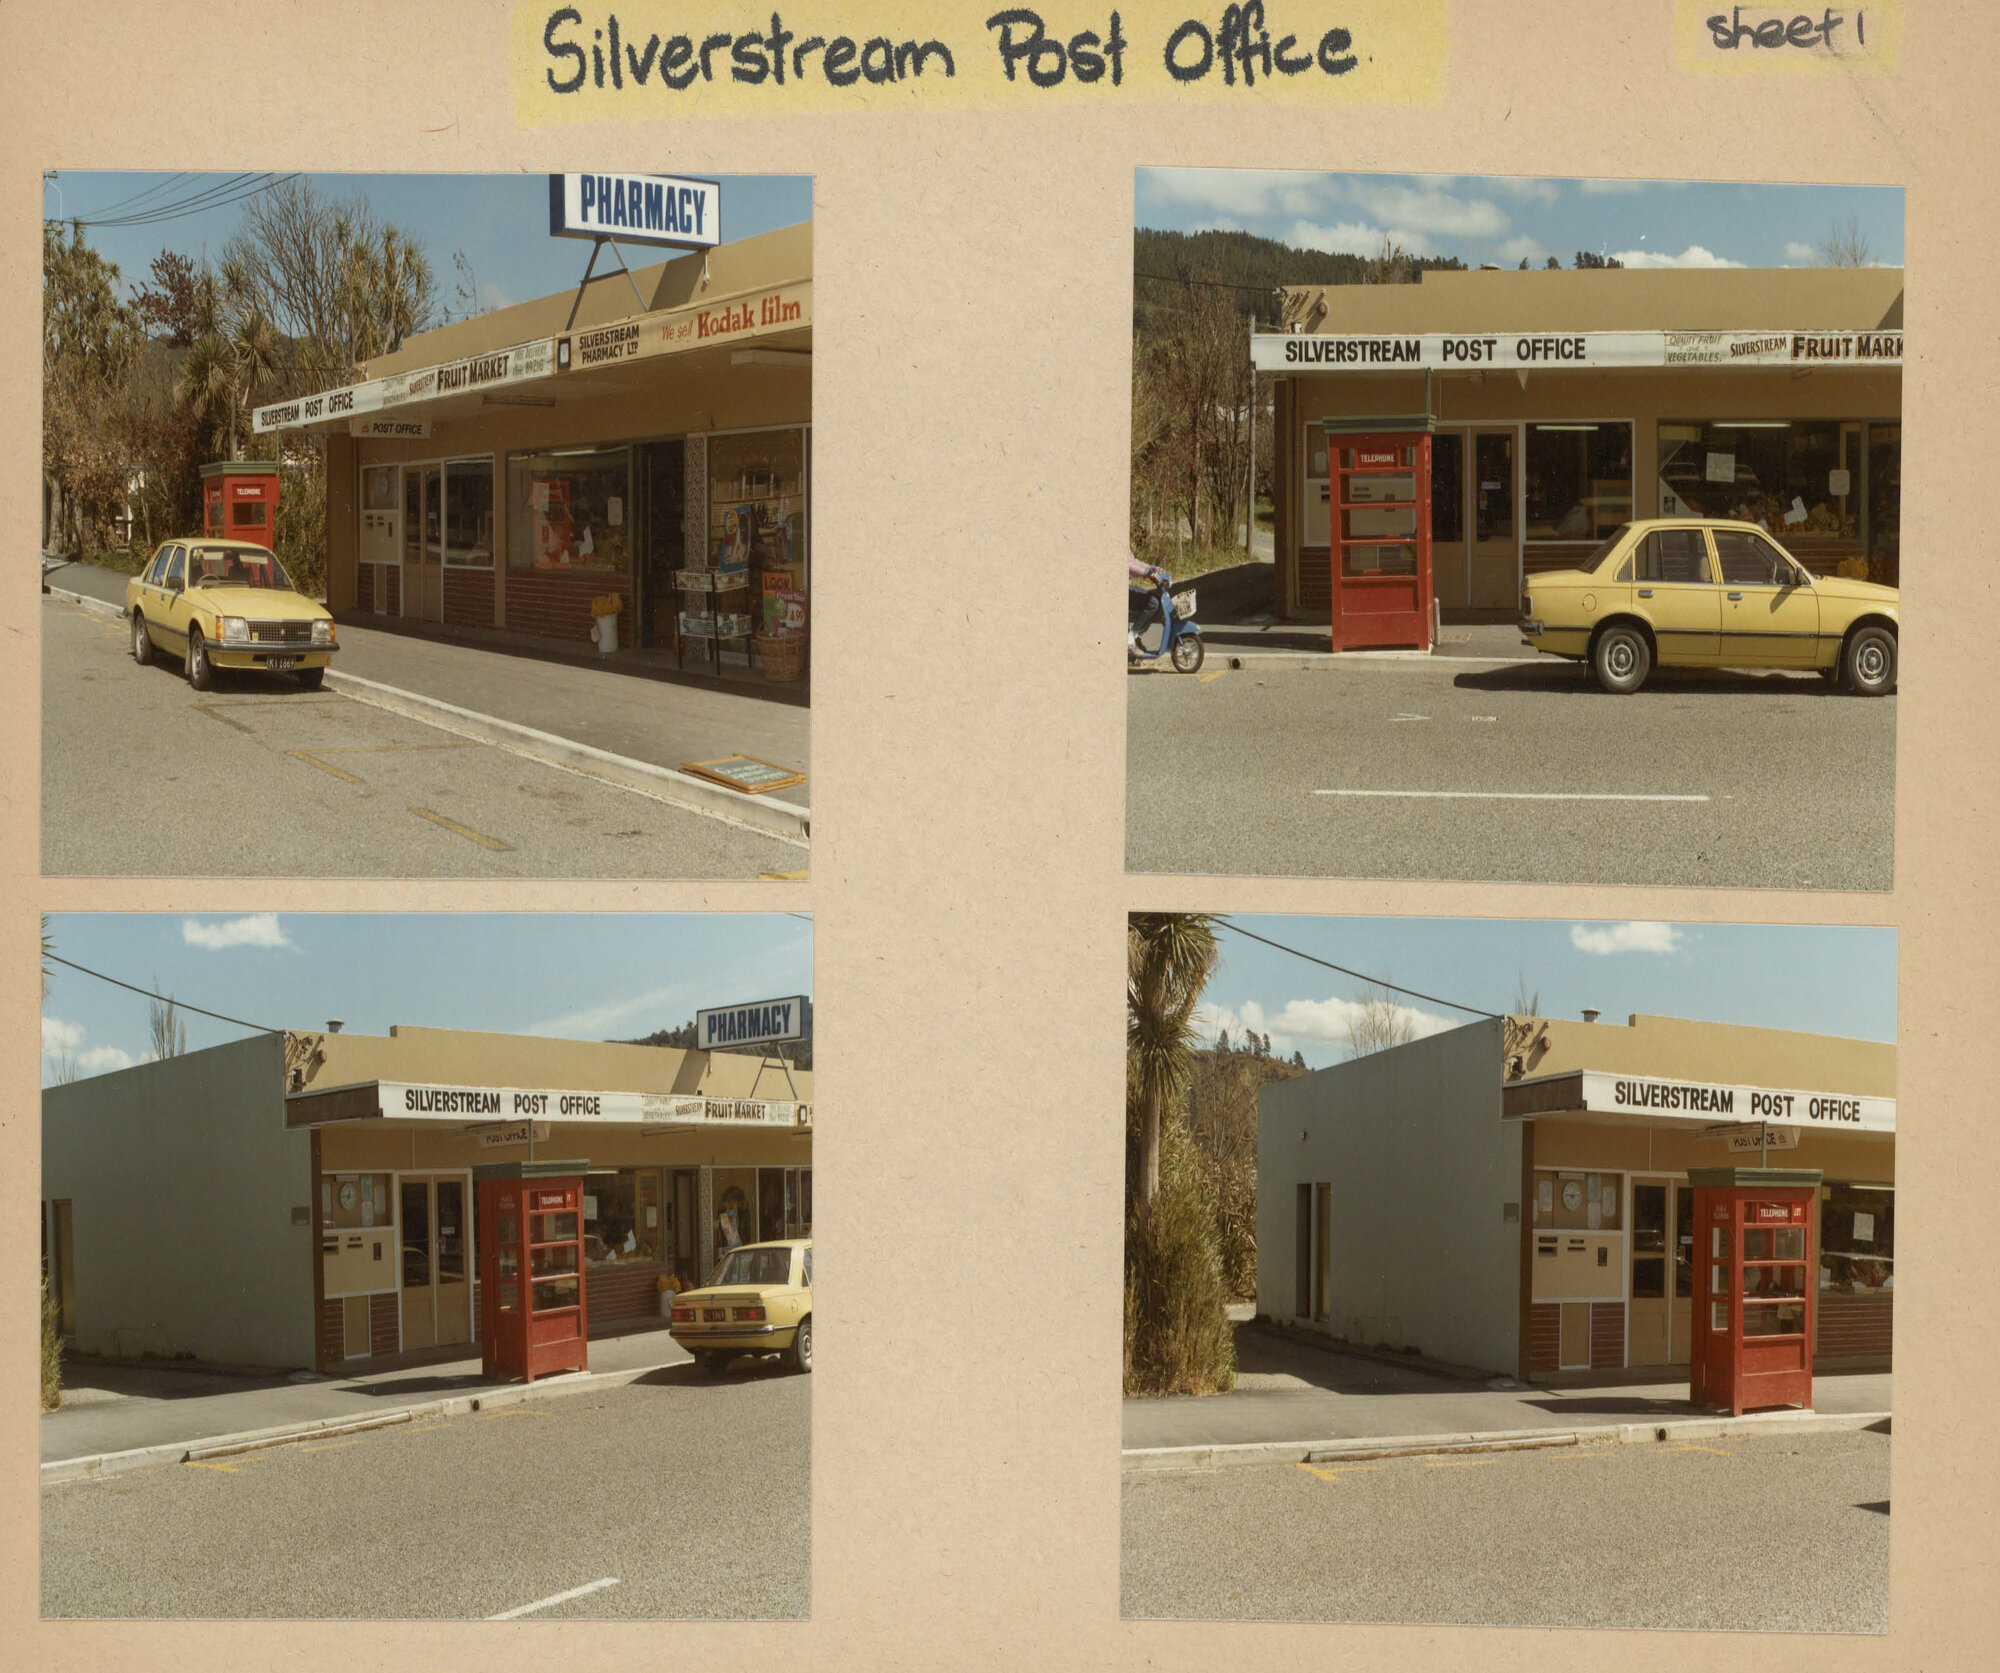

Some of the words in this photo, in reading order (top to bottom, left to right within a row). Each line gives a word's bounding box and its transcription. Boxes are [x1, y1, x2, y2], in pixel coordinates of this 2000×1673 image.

[1706, 6, 1844, 49] sheet
[1857, 10, 1865, 45] 1
[541, 7, 956, 94] Silverstream
[987, 8, 1127, 87] Post
[1163, 0, 1360, 86] Office
[580, 174, 706, 236] PHARMACY
[662, 325, 675, 341] We
[677, 319, 694, 338] sell
[697, 303, 755, 340] Kodak
[761, 295, 802, 326] film
[579, 325, 640, 350] SILVERSTREAM
[1285, 340, 1421, 362] SILVERSTREAM
[1442, 339, 1497, 361] POST
[1516, 338, 1585, 360] OFFICE
[1698, 335, 1722, 345] FRUIT
[1730, 336, 1787, 358] SILVERSTREAM
[1792, 336, 1852, 359] FRUIT
[582, 344, 624, 364] PHARMACY
[437, 364, 468, 391] FRUIT
[469, 355, 510, 383] MARKET
[261, 403, 300, 427] SILVERSTREAM
[305, 398, 323, 418] POST
[329, 391, 354, 414] OFFICE
[372, 423, 395, 434] POST
[395, 424, 422, 435] OFFICE
[1361, 453, 1395, 462] TELEPHONE
[764, 575, 790, 591] LOOK
[707, 1003, 791, 1044] PHARMACY
[405, 1089, 501, 1113] SILVERSTREAM
[514, 1094, 548, 1114] POST
[560, 1096, 601, 1115] OFFICE
[705, 1101, 733, 1119] FRUIT
[734, 1102, 766, 1120] MARKET
[1615, 1081, 1733, 1113] SILVERSTREAM
[1751, 1092, 1794, 1117] POST
[1809, 1097, 1860, 1122] OFFICE
[1760, 1208, 1788, 1217] TELEPHONE
